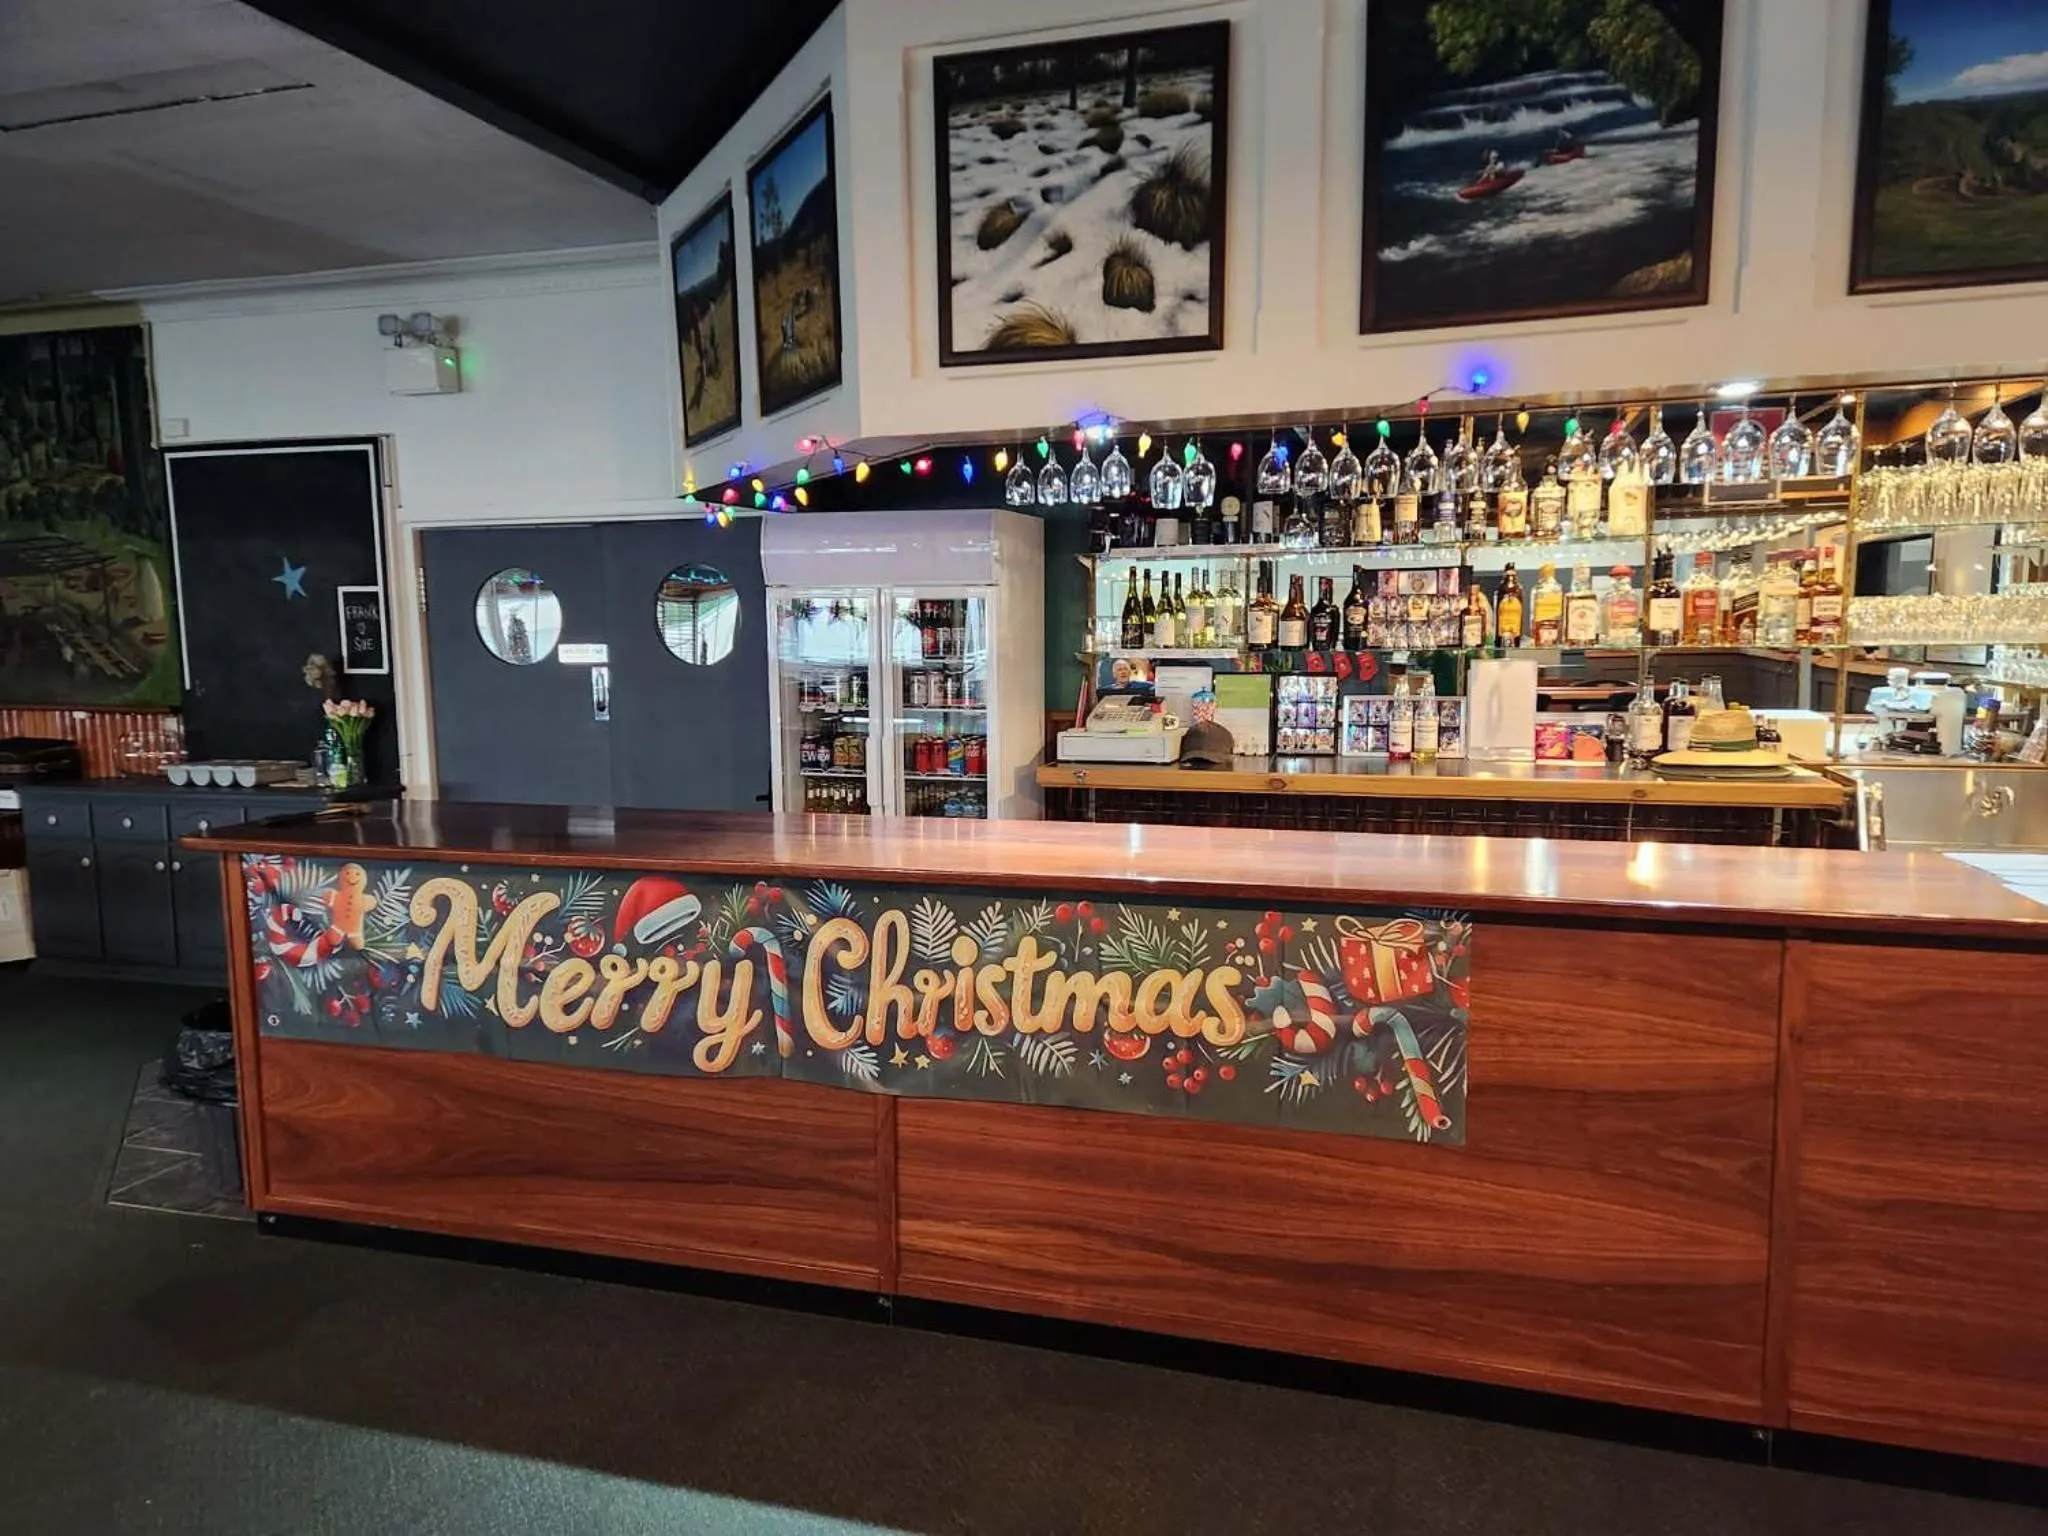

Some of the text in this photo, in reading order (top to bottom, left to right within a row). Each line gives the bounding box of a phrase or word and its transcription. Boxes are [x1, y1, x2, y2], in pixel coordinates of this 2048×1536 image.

[353, 636, 375, 652] SUE
[410, 876, 1249, 1073] Merry Christmas
